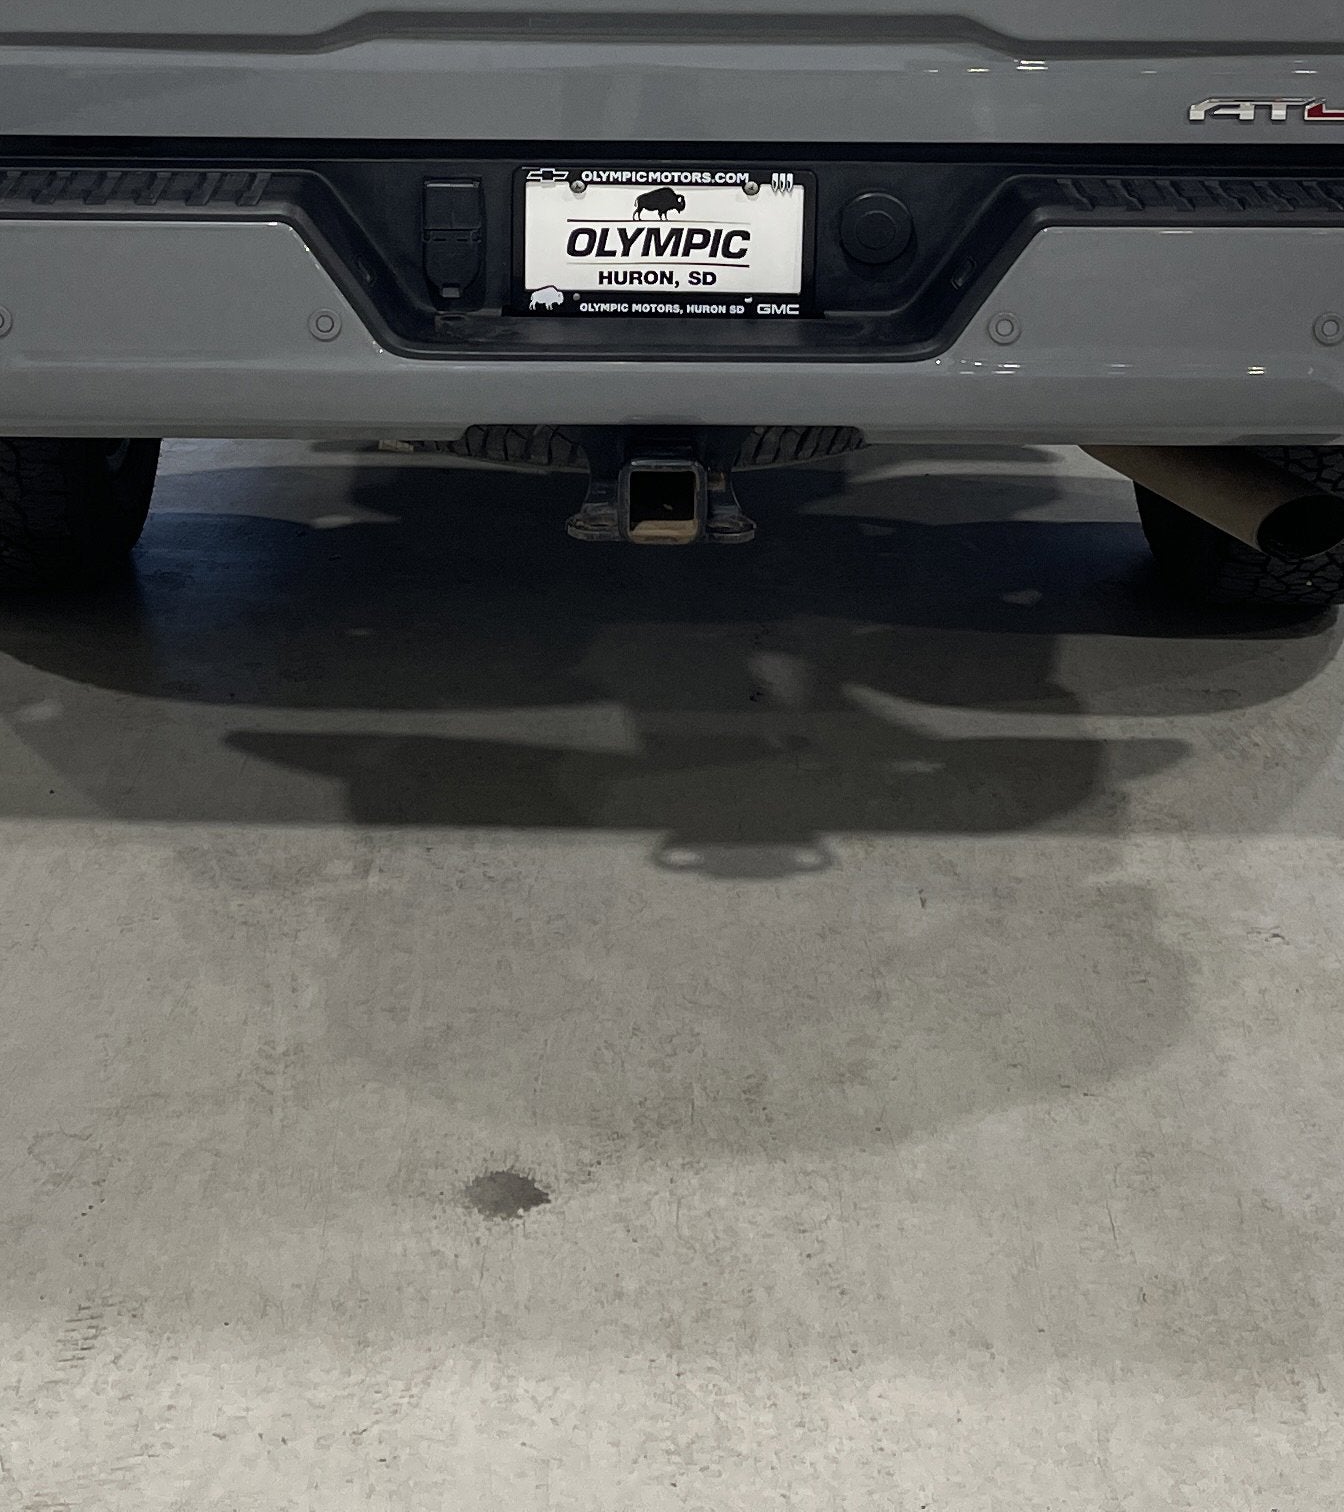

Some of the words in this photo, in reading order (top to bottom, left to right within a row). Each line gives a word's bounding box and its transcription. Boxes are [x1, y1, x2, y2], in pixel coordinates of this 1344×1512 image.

[581, 170, 749, 184] OLYMPICMOTORS.COM
[566, 227, 750, 259] OLYMPIC
[599, 270, 680, 287] HURON,
[688, 271, 717, 286] SD
[579, 303, 628, 313] OLYMPIC
[632, 303, 684, 315] MOTORS,
[687, 304, 727, 314] HURON
[729, 305, 745, 314] SD
[757, 304, 799, 315] GMC
